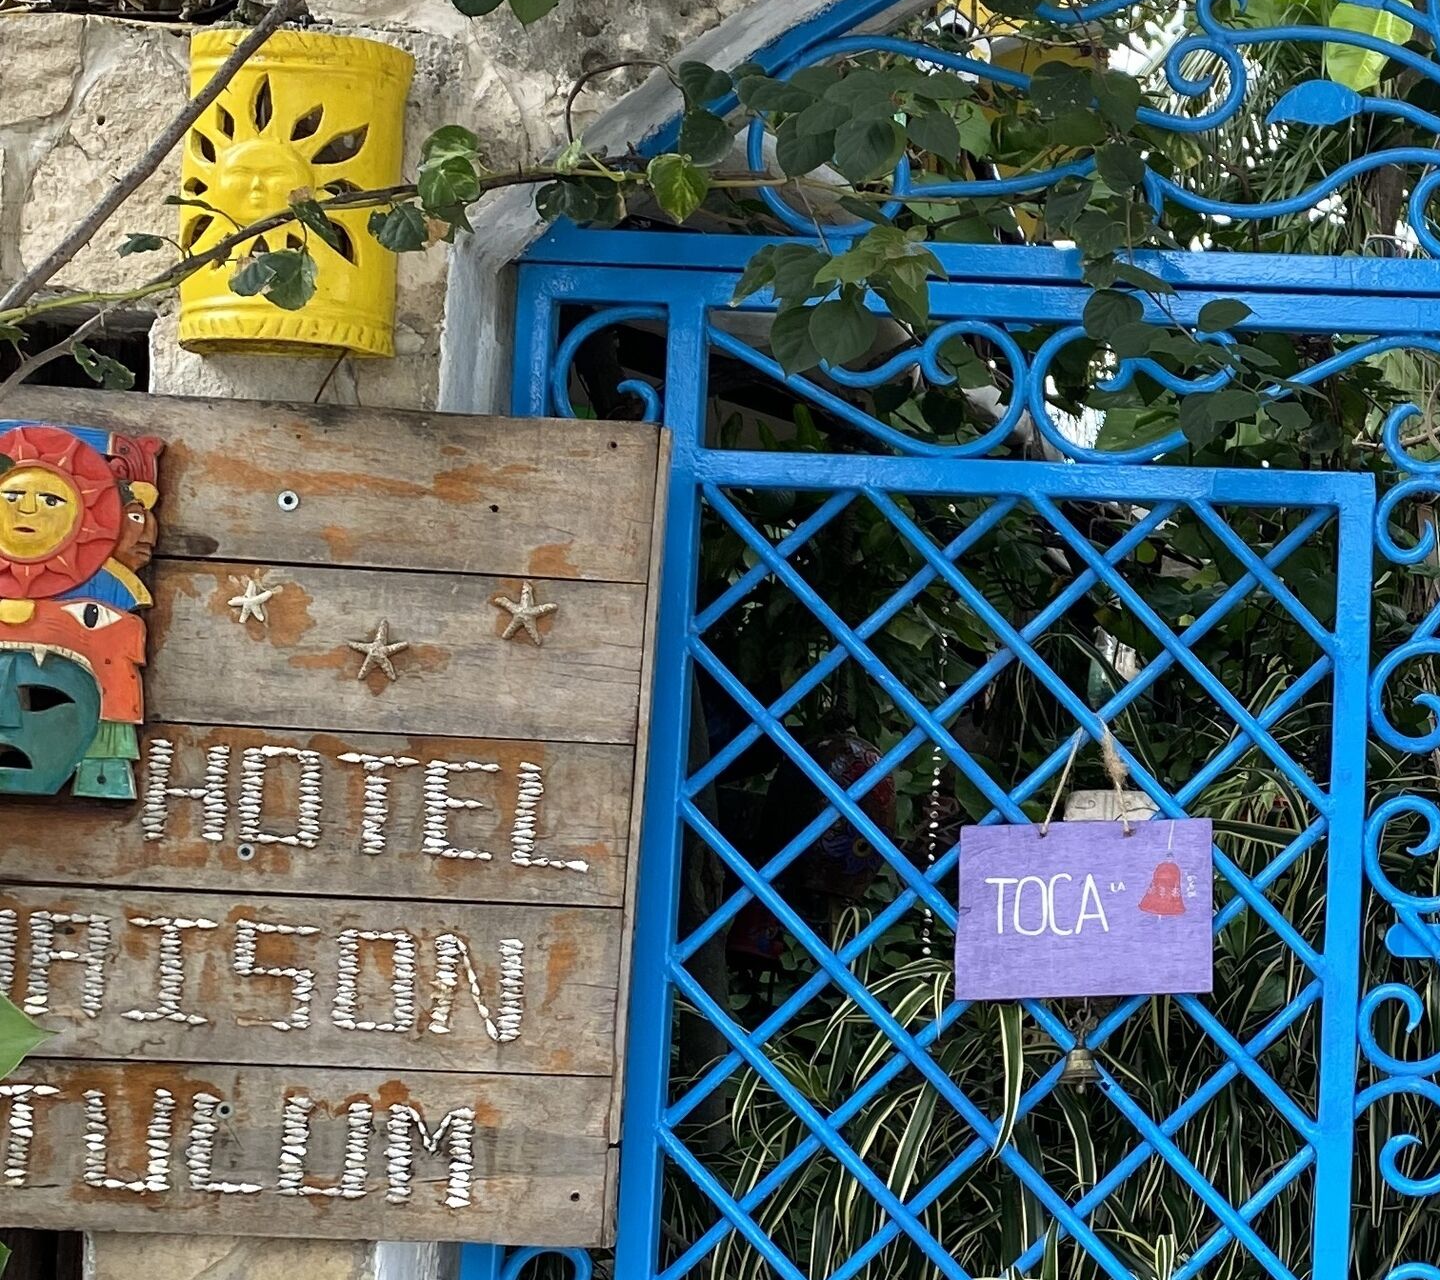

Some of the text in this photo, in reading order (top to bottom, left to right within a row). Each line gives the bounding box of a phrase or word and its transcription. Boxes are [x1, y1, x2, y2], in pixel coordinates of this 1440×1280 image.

[142, 738, 589, 872] HOTEL
[985, 873, 1126, 936] TOCA LA
[0, 908, 525, 1042] AISON
[0, 1083, 476, 1209] TULUM
